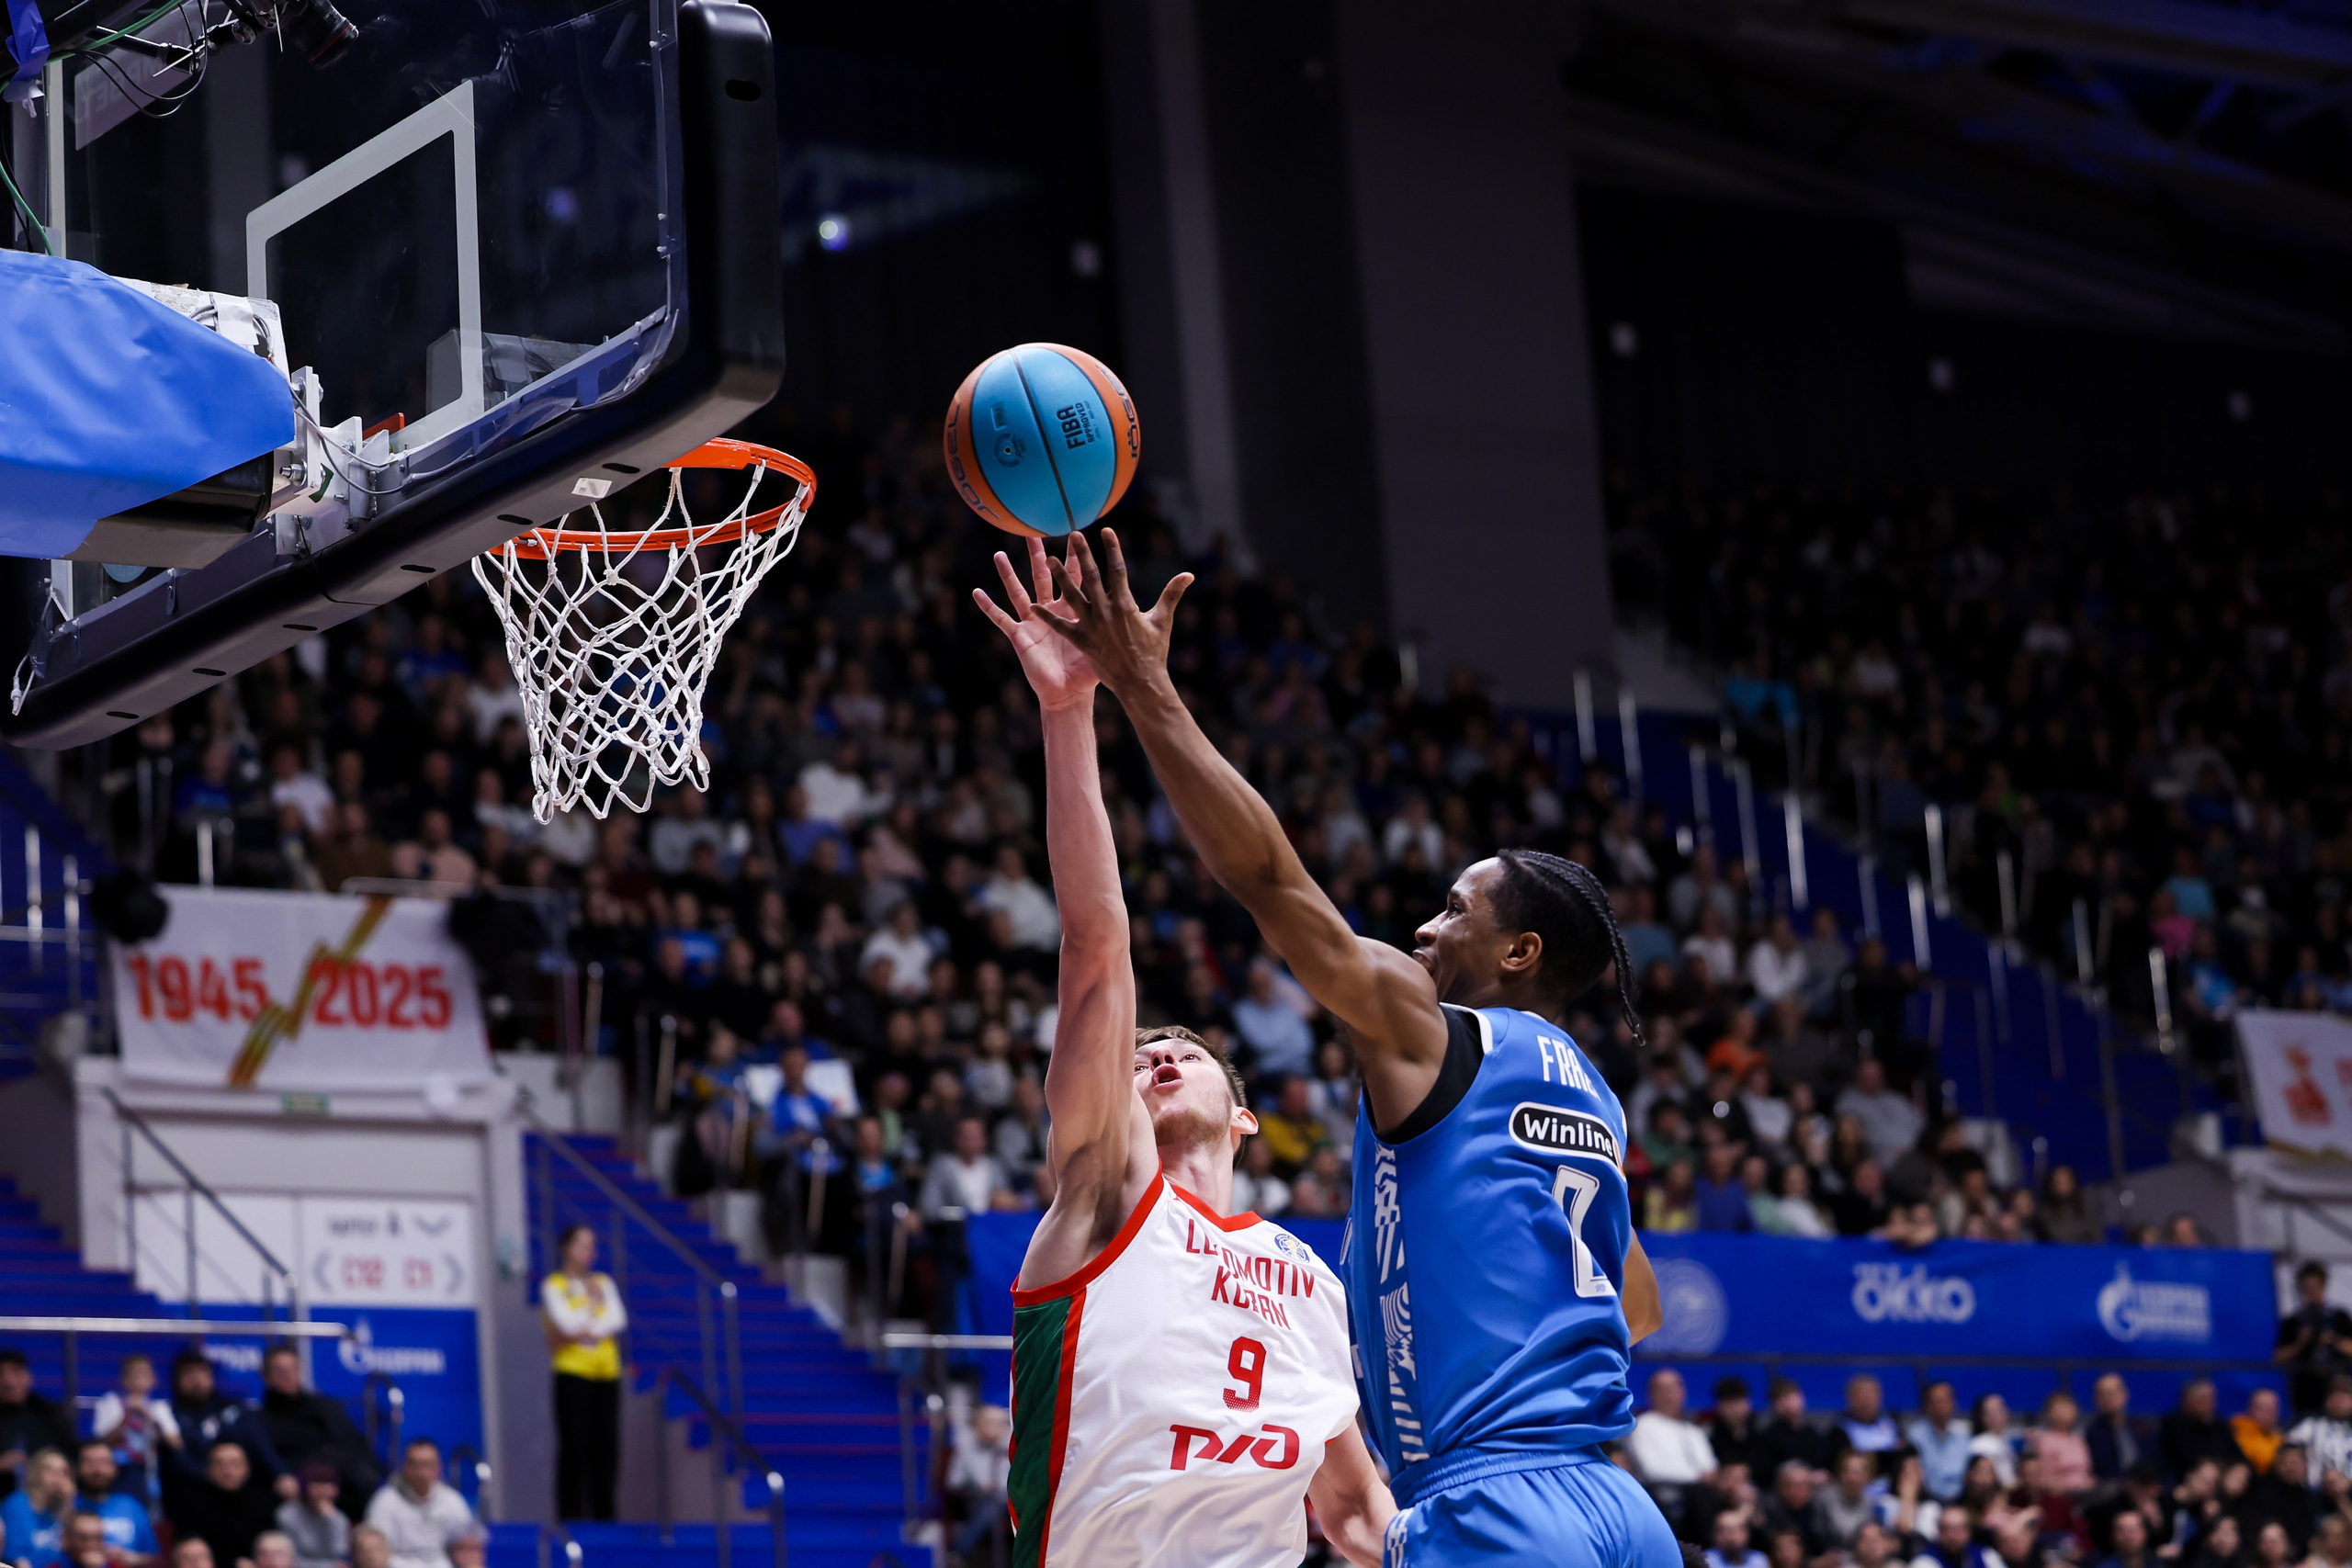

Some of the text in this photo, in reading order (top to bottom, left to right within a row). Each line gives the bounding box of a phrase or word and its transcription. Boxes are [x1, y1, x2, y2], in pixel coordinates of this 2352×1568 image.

[1057, 405, 1087, 450] FIBA
[1075, 402, 1095, 444] APPROVED
[127, 953, 269, 1022] 1945
[309, 956, 453, 1031] 2025
[1523, 1112, 1613, 1156] Winline
[1223, 1336, 1267, 1413] 9
